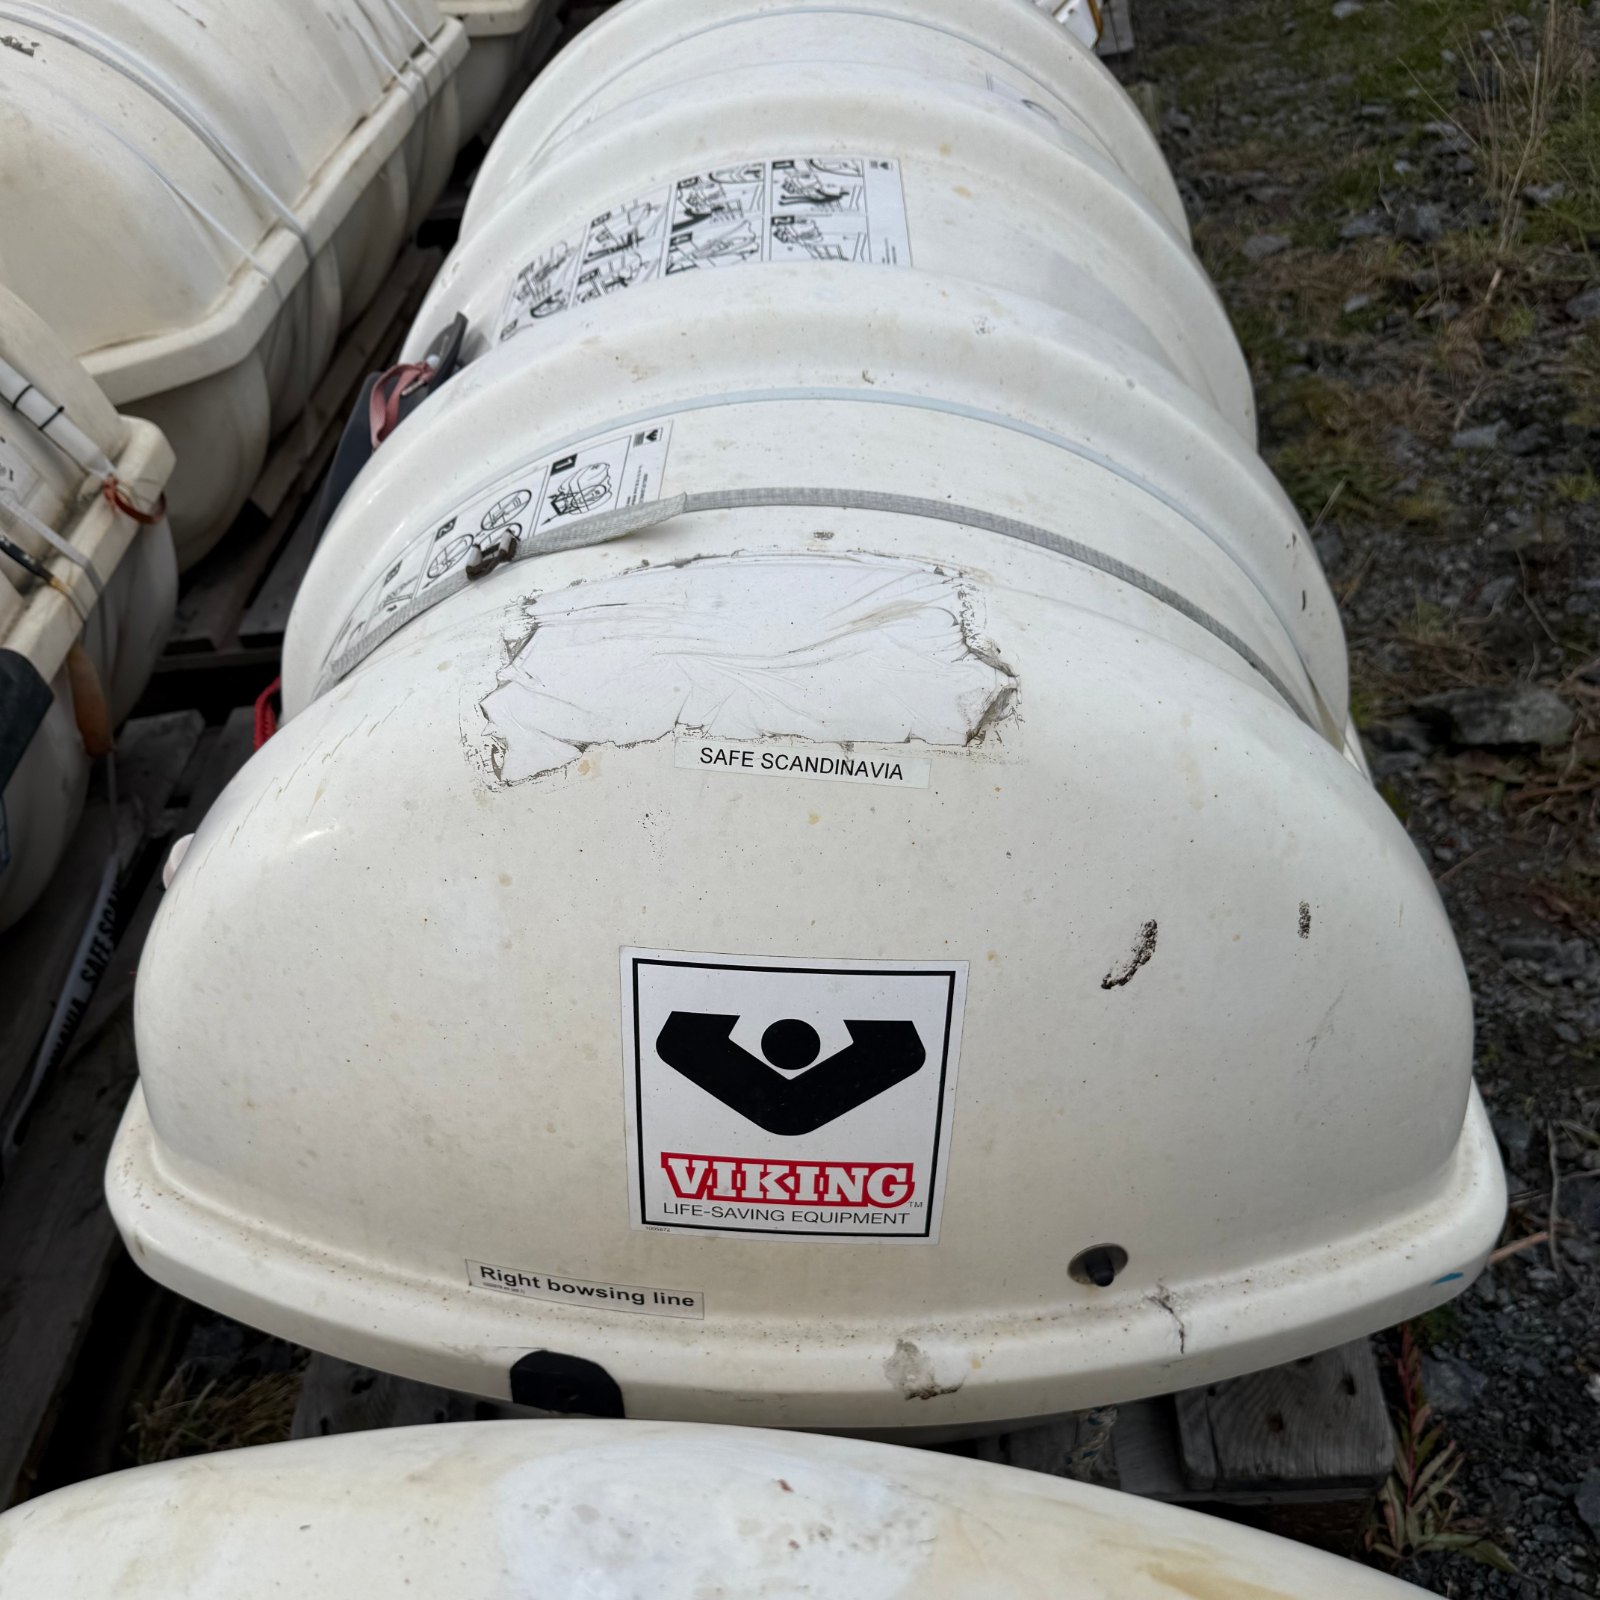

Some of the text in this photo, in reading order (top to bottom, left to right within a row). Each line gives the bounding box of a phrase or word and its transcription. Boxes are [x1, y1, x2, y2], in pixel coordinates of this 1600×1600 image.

[700, 747, 903, 780] SAFE SCANDINAVIA
[661, 1152, 915, 1208] VIKING
[663, 1202, 910, 1225] LIFE-SAVING EQUIPMENT
[480, 1266, 541, 1289] Right
[547, 1278, 645, 1305] bowsing
[653, 1291, 695, 1307] line
